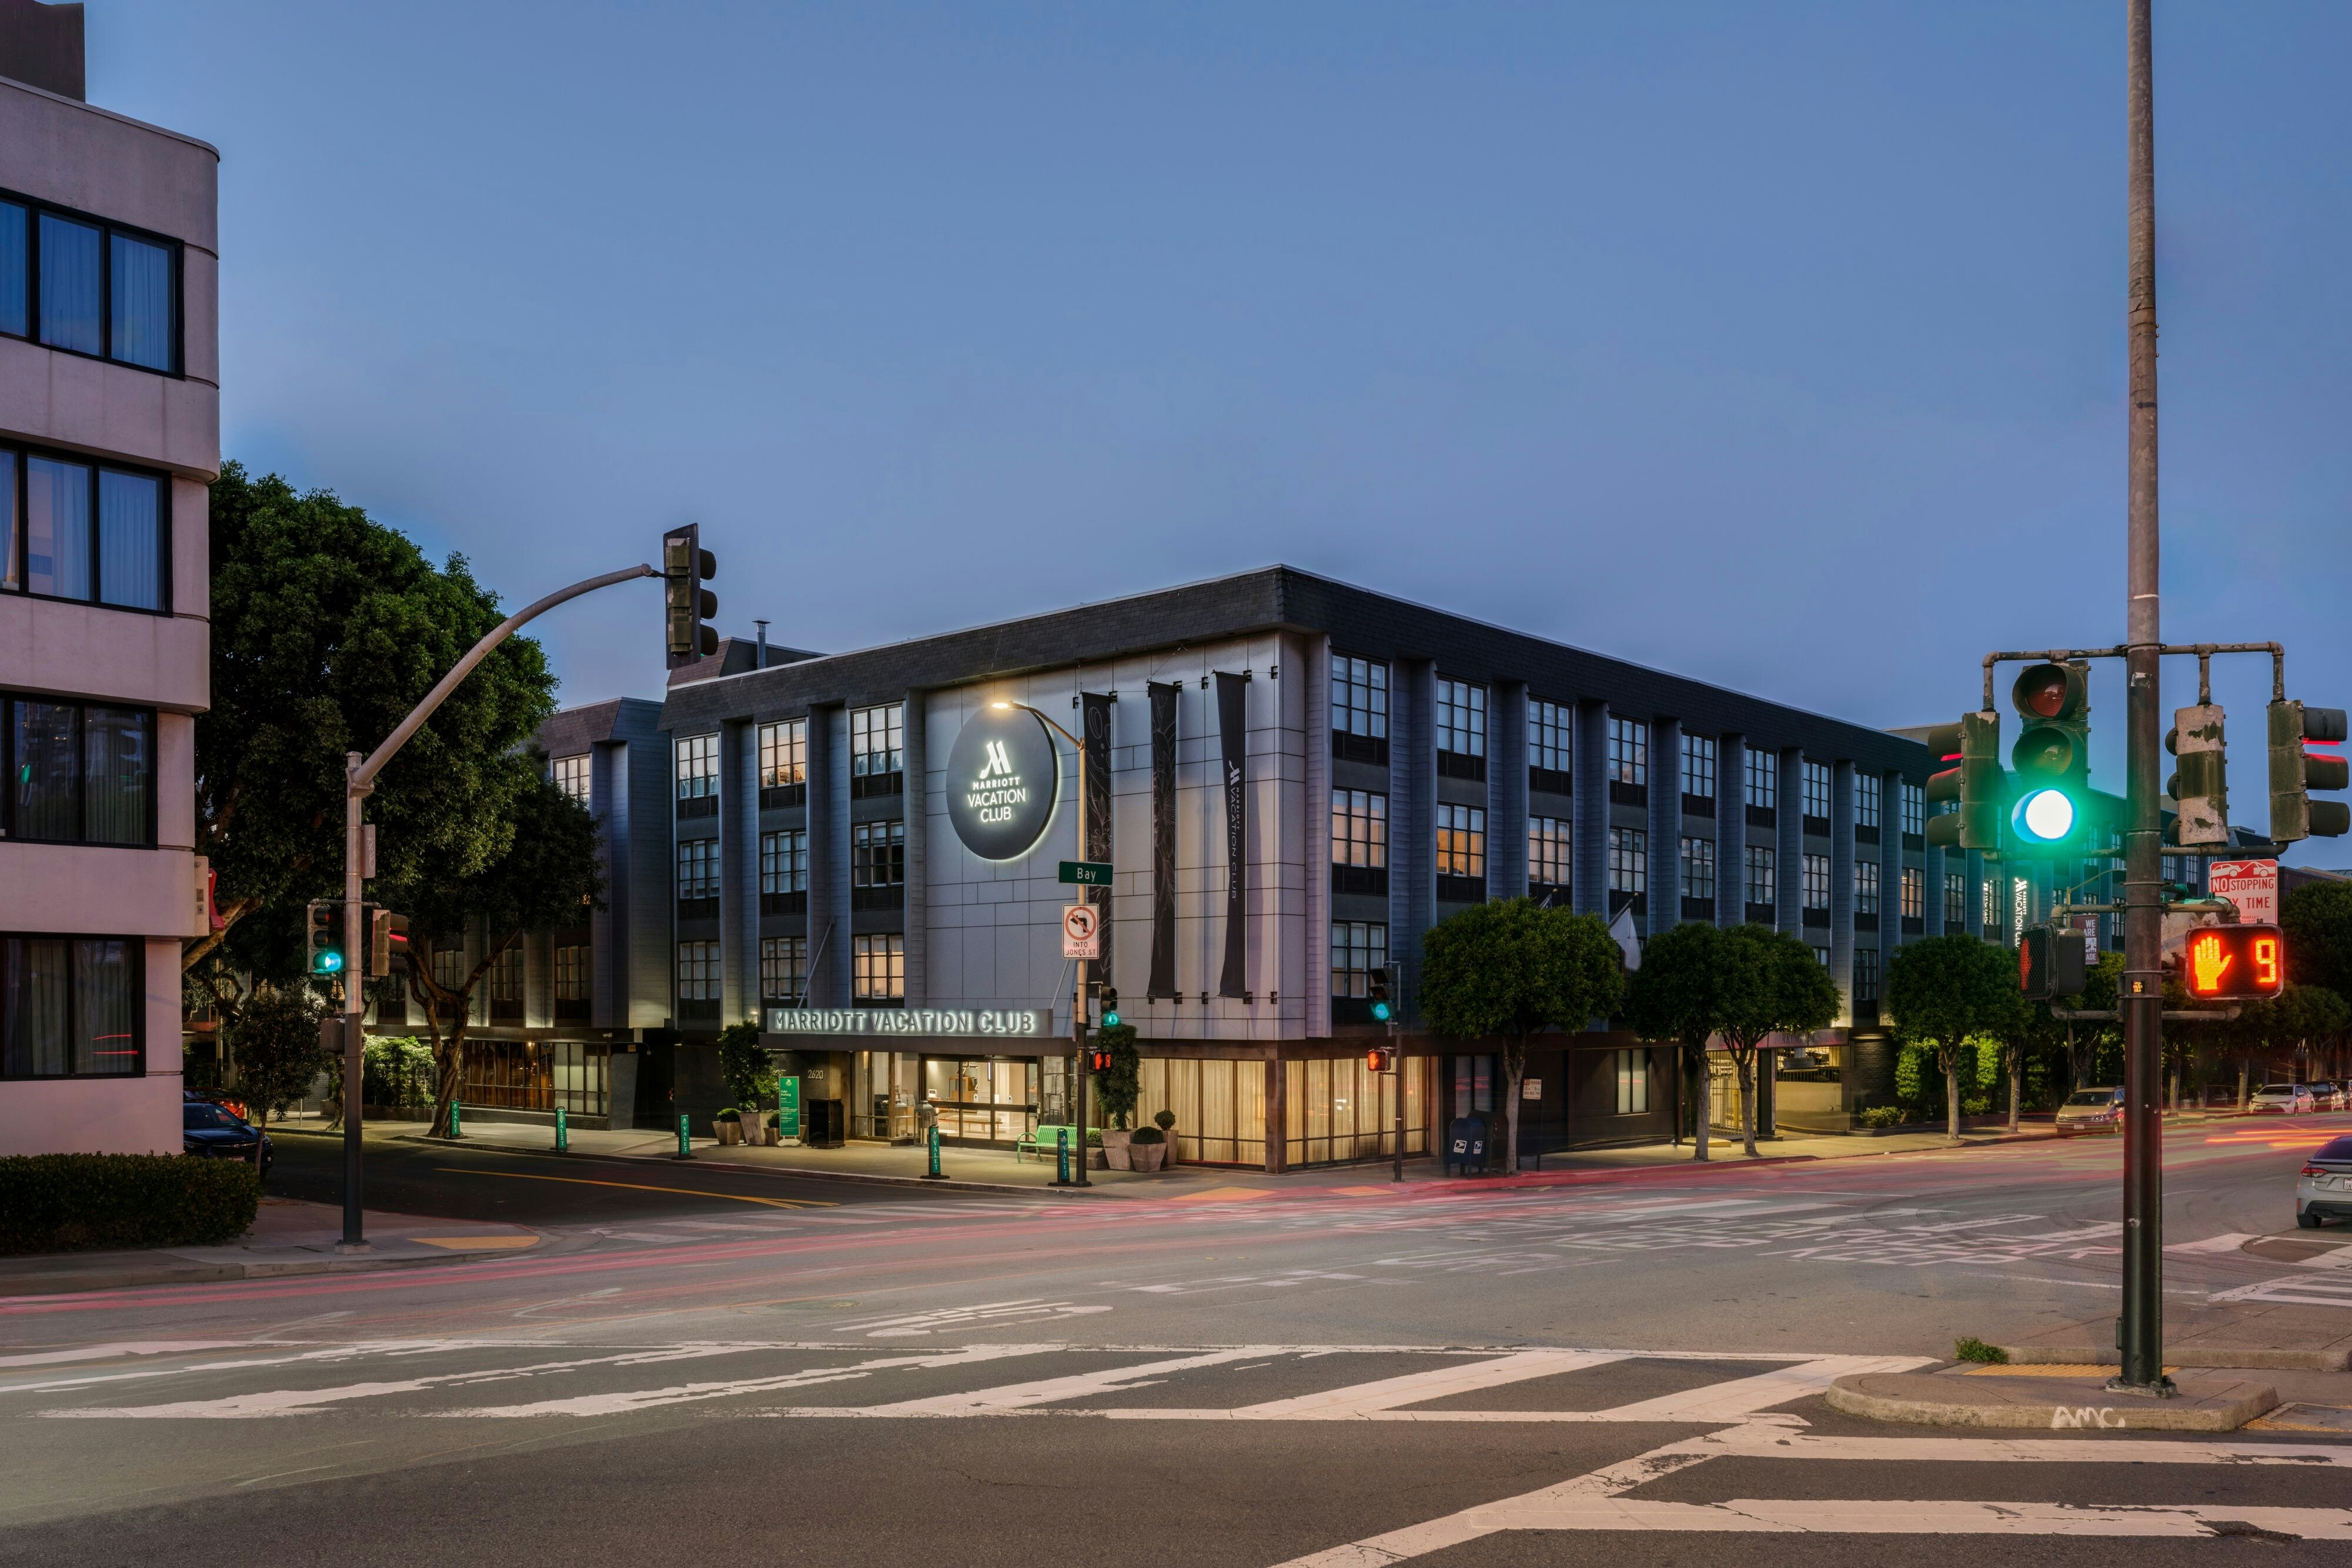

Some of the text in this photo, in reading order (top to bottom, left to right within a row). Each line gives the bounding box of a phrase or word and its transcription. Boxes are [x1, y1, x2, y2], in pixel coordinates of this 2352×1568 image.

[973, 777, 1020, 790] MARRIOTT
[967, 788, 1025, 807] VACATION
[980, 807, 1011, 823] CLUB
[1077, 867, 1096, 882] Bay
[2212, 878, 2274, 892] NO STOPPING
[2246, 897, 2270, 909] TIME
[2086, 920, 2096, 928] WE
[2083, 928, 2096, 937] ARE
[2255, 939, 2277, 983] 9
[775, 1012, 1034, 1032] MARRIOTT VACATION CLUB
[808, 1070, 823, 1079] 2620
[1628, 1219, 1887, 1241] CLEAR
[1523, 1229, 1772, 1250] KEEP
[1845, 1232, 2123, 1259] CLEAR
[1754, 1244, 2026, 1266] KEEP
